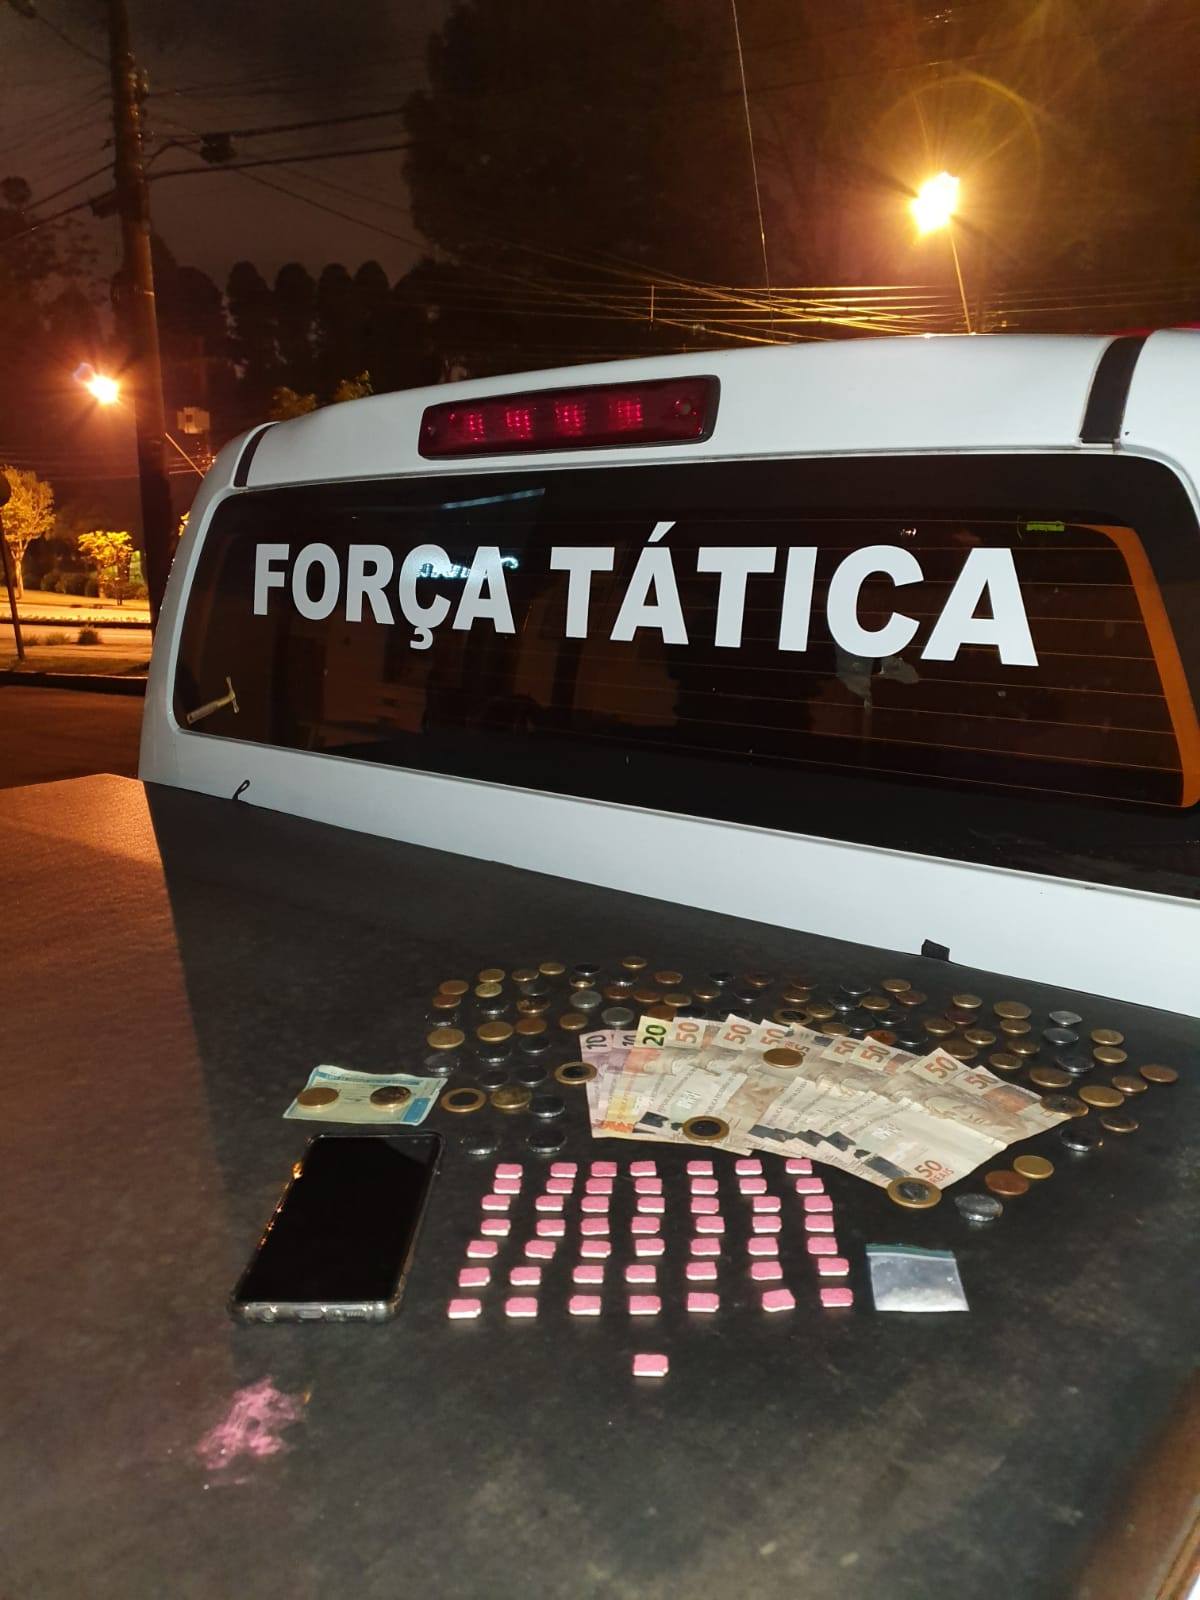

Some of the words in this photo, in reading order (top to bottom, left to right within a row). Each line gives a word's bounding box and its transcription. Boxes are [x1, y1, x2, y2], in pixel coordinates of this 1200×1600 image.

[253, 542, 516, 650] FORÇA
[550, 521, 1039, 667] TÁTICA
[585, 1034, 608, 1050] 10
[642, 1024, 667, 1047] 20
[675, 1022, 700, 1044] 50
[723, 1024, 752, 1044] 50
[760, 1028, 786, 1045] 50
[860, 1045, 890, 1063] 50
[924, 1056, 959, 1080] 50
[964, 1073, 1000, 1090] 50
[914, 1160, 943, 1178] 50
